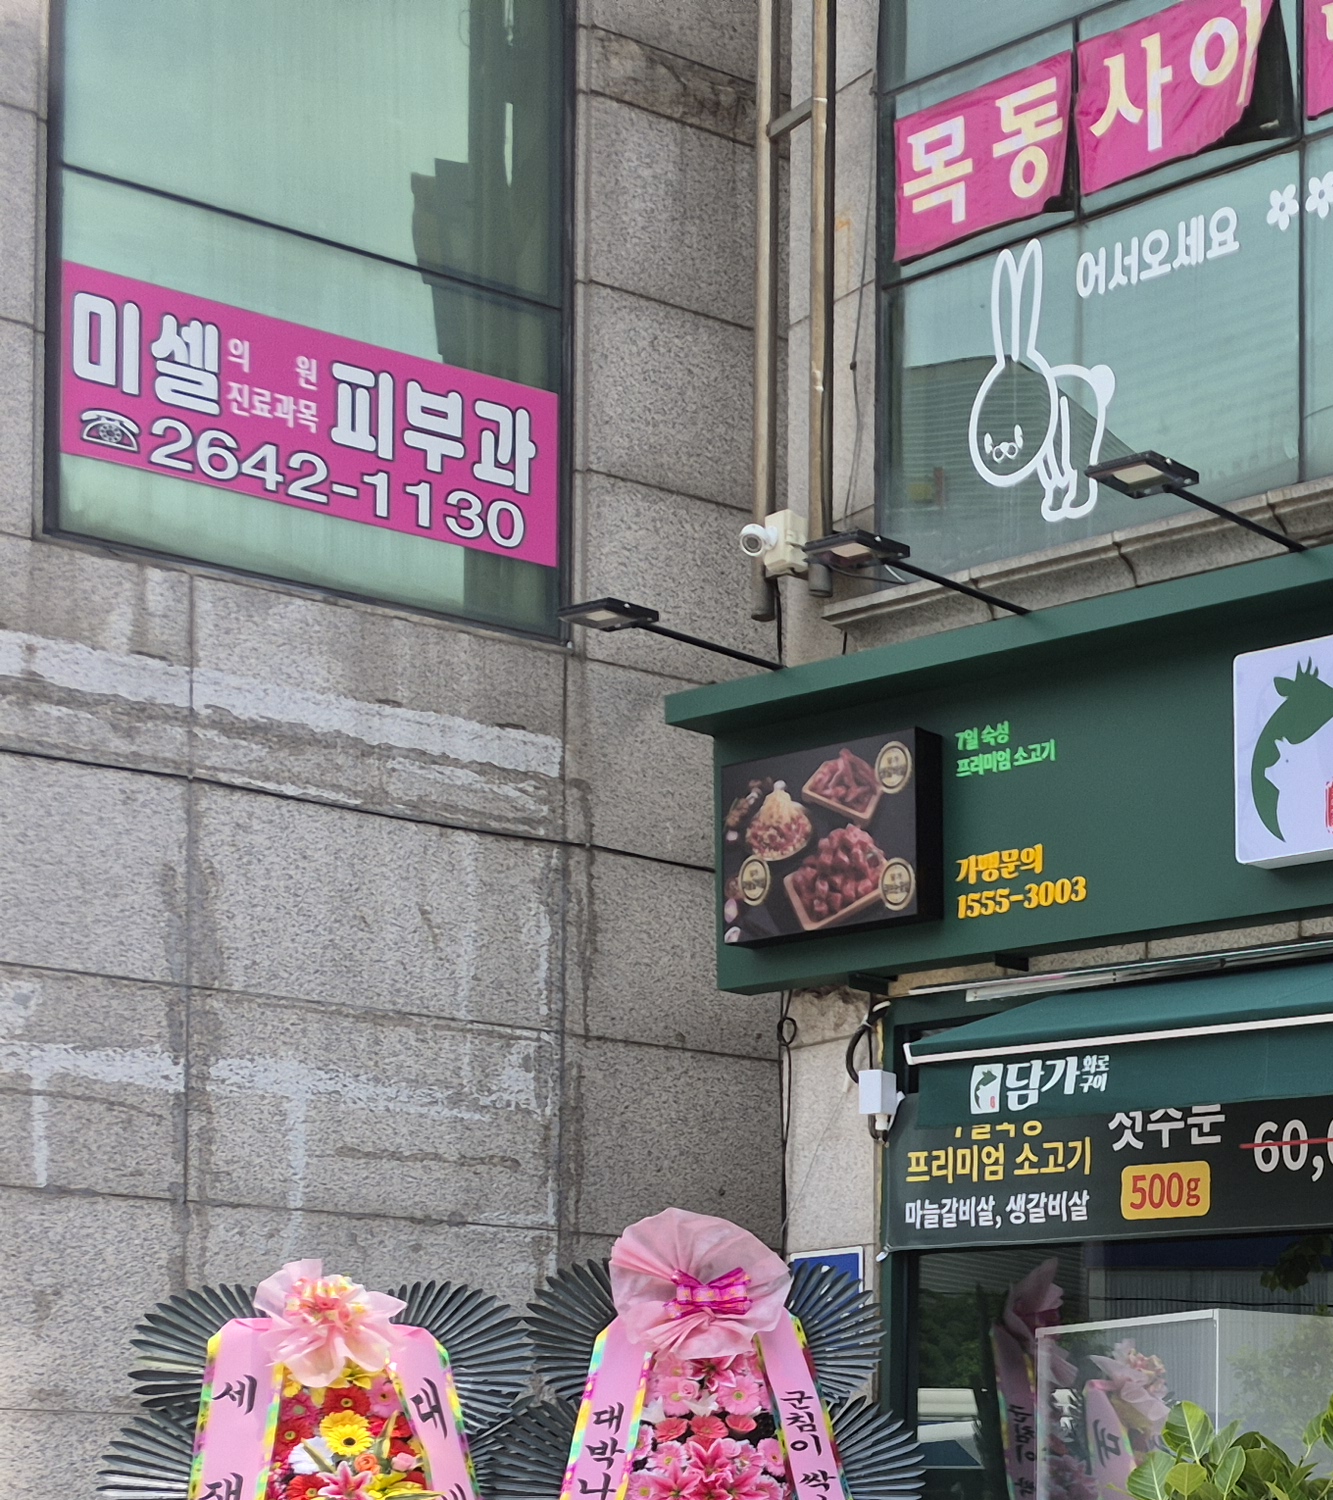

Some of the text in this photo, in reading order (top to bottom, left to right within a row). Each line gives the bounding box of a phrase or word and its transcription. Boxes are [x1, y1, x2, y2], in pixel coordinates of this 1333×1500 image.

[1075, 206, 1240, 298] 어서오세요
[227, 386, 319, 434] 진료과목
[331, 360, 538, 494] 피부과
[149, 415, 526, 549] 2642-1130
[956, 720, 1011, 753] 7일 숙성
[956, 738, 1057, 778] 프리미엄 소고기
[956, 842, 1044, 886] 가맹문의
[956, 875, 1088, 920] 1555-3003
[1003, 1054, 1111, 1112] 담가 화로 구이
[905, 1136, 1093, 1185] 프리미엄 소고기
[904, 1189, 1090, 1232] 마늘갈비살, 생갈비살
[1129, 1170, 1201, 1211] 500g
[779, 1389, 823, 1457] 군침이
